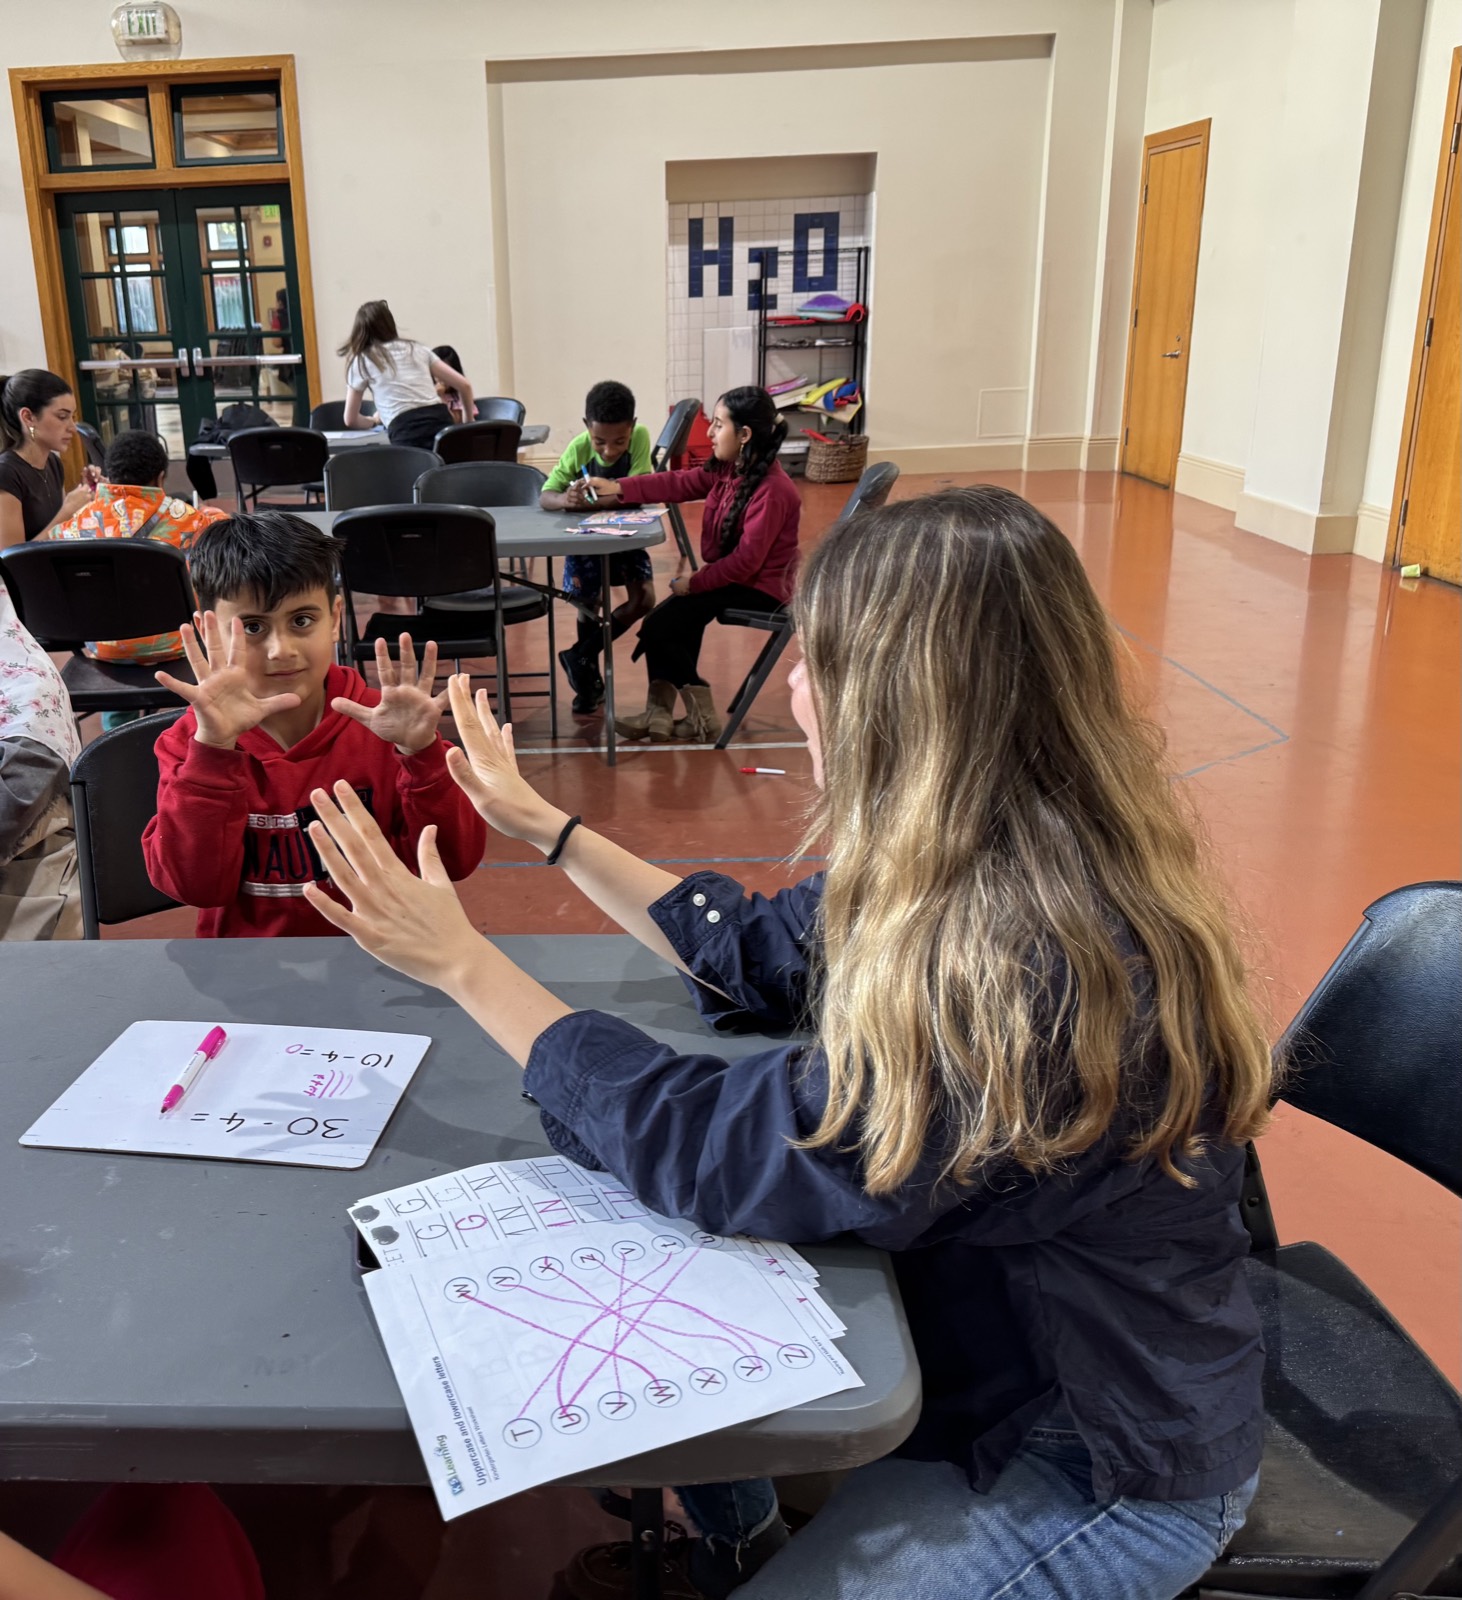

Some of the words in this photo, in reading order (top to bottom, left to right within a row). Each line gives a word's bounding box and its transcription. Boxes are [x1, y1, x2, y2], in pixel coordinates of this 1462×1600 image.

[126, 9, 158, 36] EXIT
[241, 829, 326, 881] NAU
[287, 1117, 350, 1139] 30
[394, 1198, 428, 1214] G
[415, 1223, 449, 1240] G
[454, 1213, 488, 1231] G
[382, 1248, 404, 1267] ET
[431, 1355, 447, 1380] letters
[739, 1364, 763, 1377] Y
[695, 1373, 722, 1389] X
[441, 1380, 463, 1421] lowercase
[648, 1385, 677, 1404] W
[604, 1401, 629, 1415] V
[455, 1420, 469, 1437] and
[510, 1428, 534, 1442] T
[435, 1433, 457, 1477] Learning
[463, 1438, 488, 1487] Uppercase
[484, 1447, 501, 1481] Kindergarten
